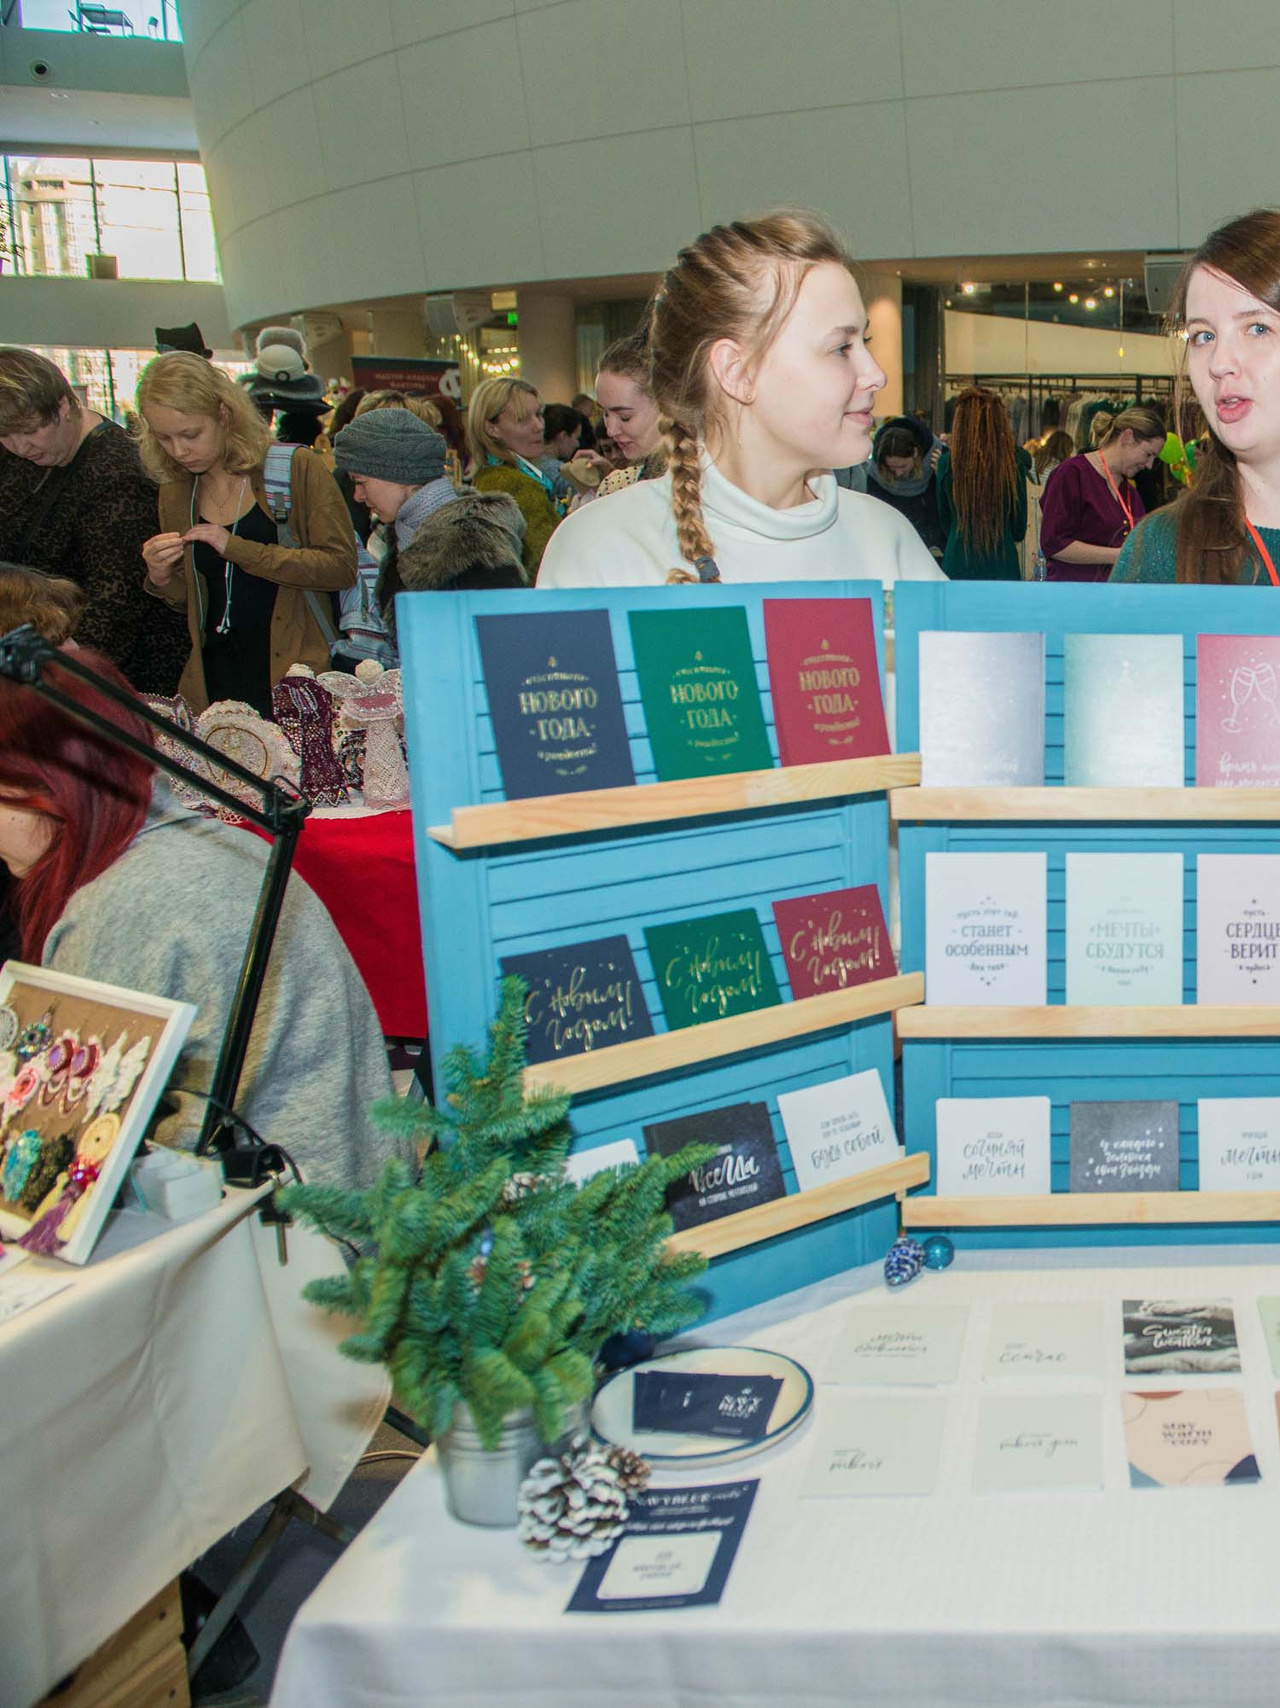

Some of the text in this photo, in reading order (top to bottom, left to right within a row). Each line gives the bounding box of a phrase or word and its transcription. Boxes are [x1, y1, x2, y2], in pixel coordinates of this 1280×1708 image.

[799, 667, 860, 692] НОВОГО
[519, 687, 597, 715] НОВОГО
[670, 681, 739, 704] НОВОГО
[813, 693, 854, 716] ГОДА
[537, 716, 591, 741] ГОДА
[686, 708, 732, 730] ГОДА
[789, 930, 807, 962] С
[1085, 942, 1165, 960] СБУДУТСЯ
[1231, 943, 1279, 959] ВЕРИТ
[665, 956, 683, 988] С
[523, 990, 544, 1026] С
